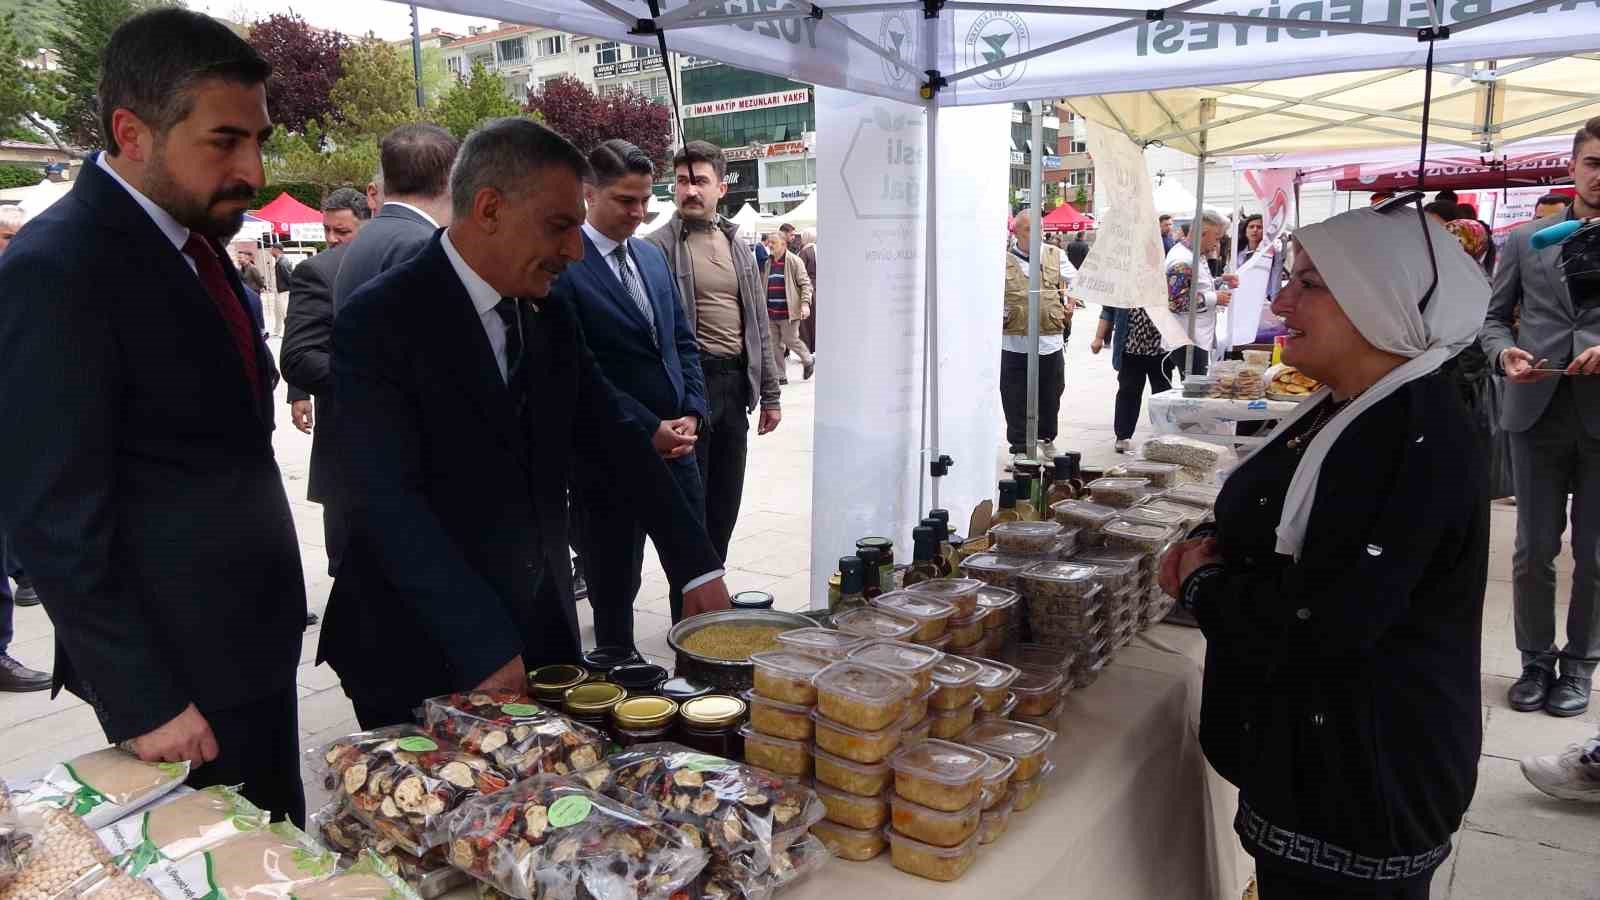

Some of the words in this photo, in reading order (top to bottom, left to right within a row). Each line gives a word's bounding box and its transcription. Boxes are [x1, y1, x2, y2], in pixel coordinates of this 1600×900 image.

[694, 105, 713, 115] İMAM
[715, 101, 736, 113] HATİP
[738, 95, 780, 108] MEZUNLARI
[783, 92, 805, 103] VAKFI
